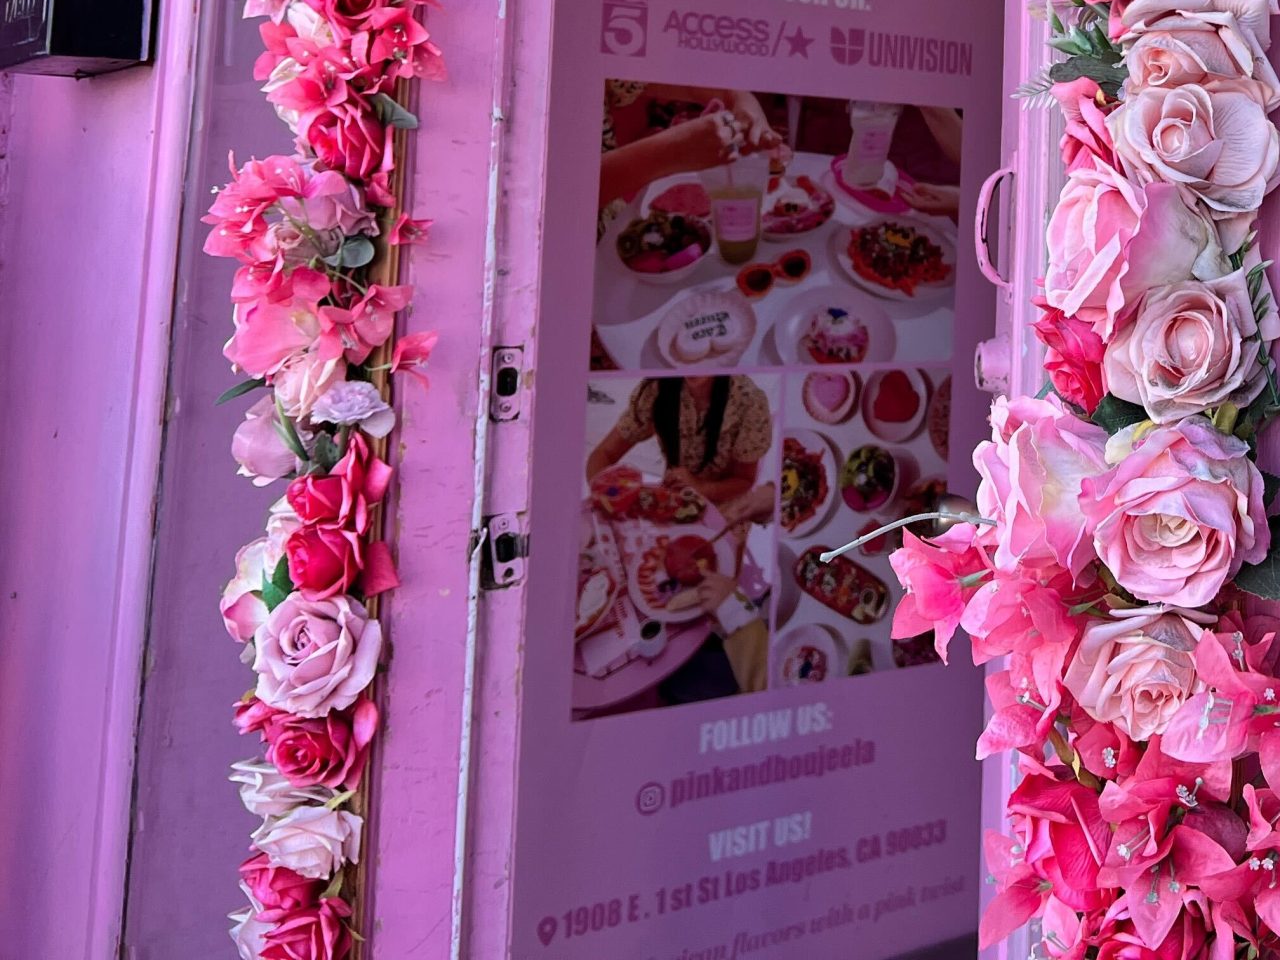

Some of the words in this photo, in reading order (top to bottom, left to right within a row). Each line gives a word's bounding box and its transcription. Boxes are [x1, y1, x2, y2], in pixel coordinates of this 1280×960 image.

[604, 7, 644, 54] 5
[678, 35, 769, 57] HOLLYWOOD
[868, 32, 972, 76] UNIVISION
[700, 708, 792, 754] FOLLOW
[796, 702, 833, 736] US:
[670, 739, 876, 809] pinkandboujeela
[709, 821, 770, 862] VISIT
[773, 811, 812, 849] US!
[697, 874, 720, 905] St
[724, 867, 760, 898] Los
[765, 848, 851, 887] Angeles,
[856, 835, 884, 863] CA
